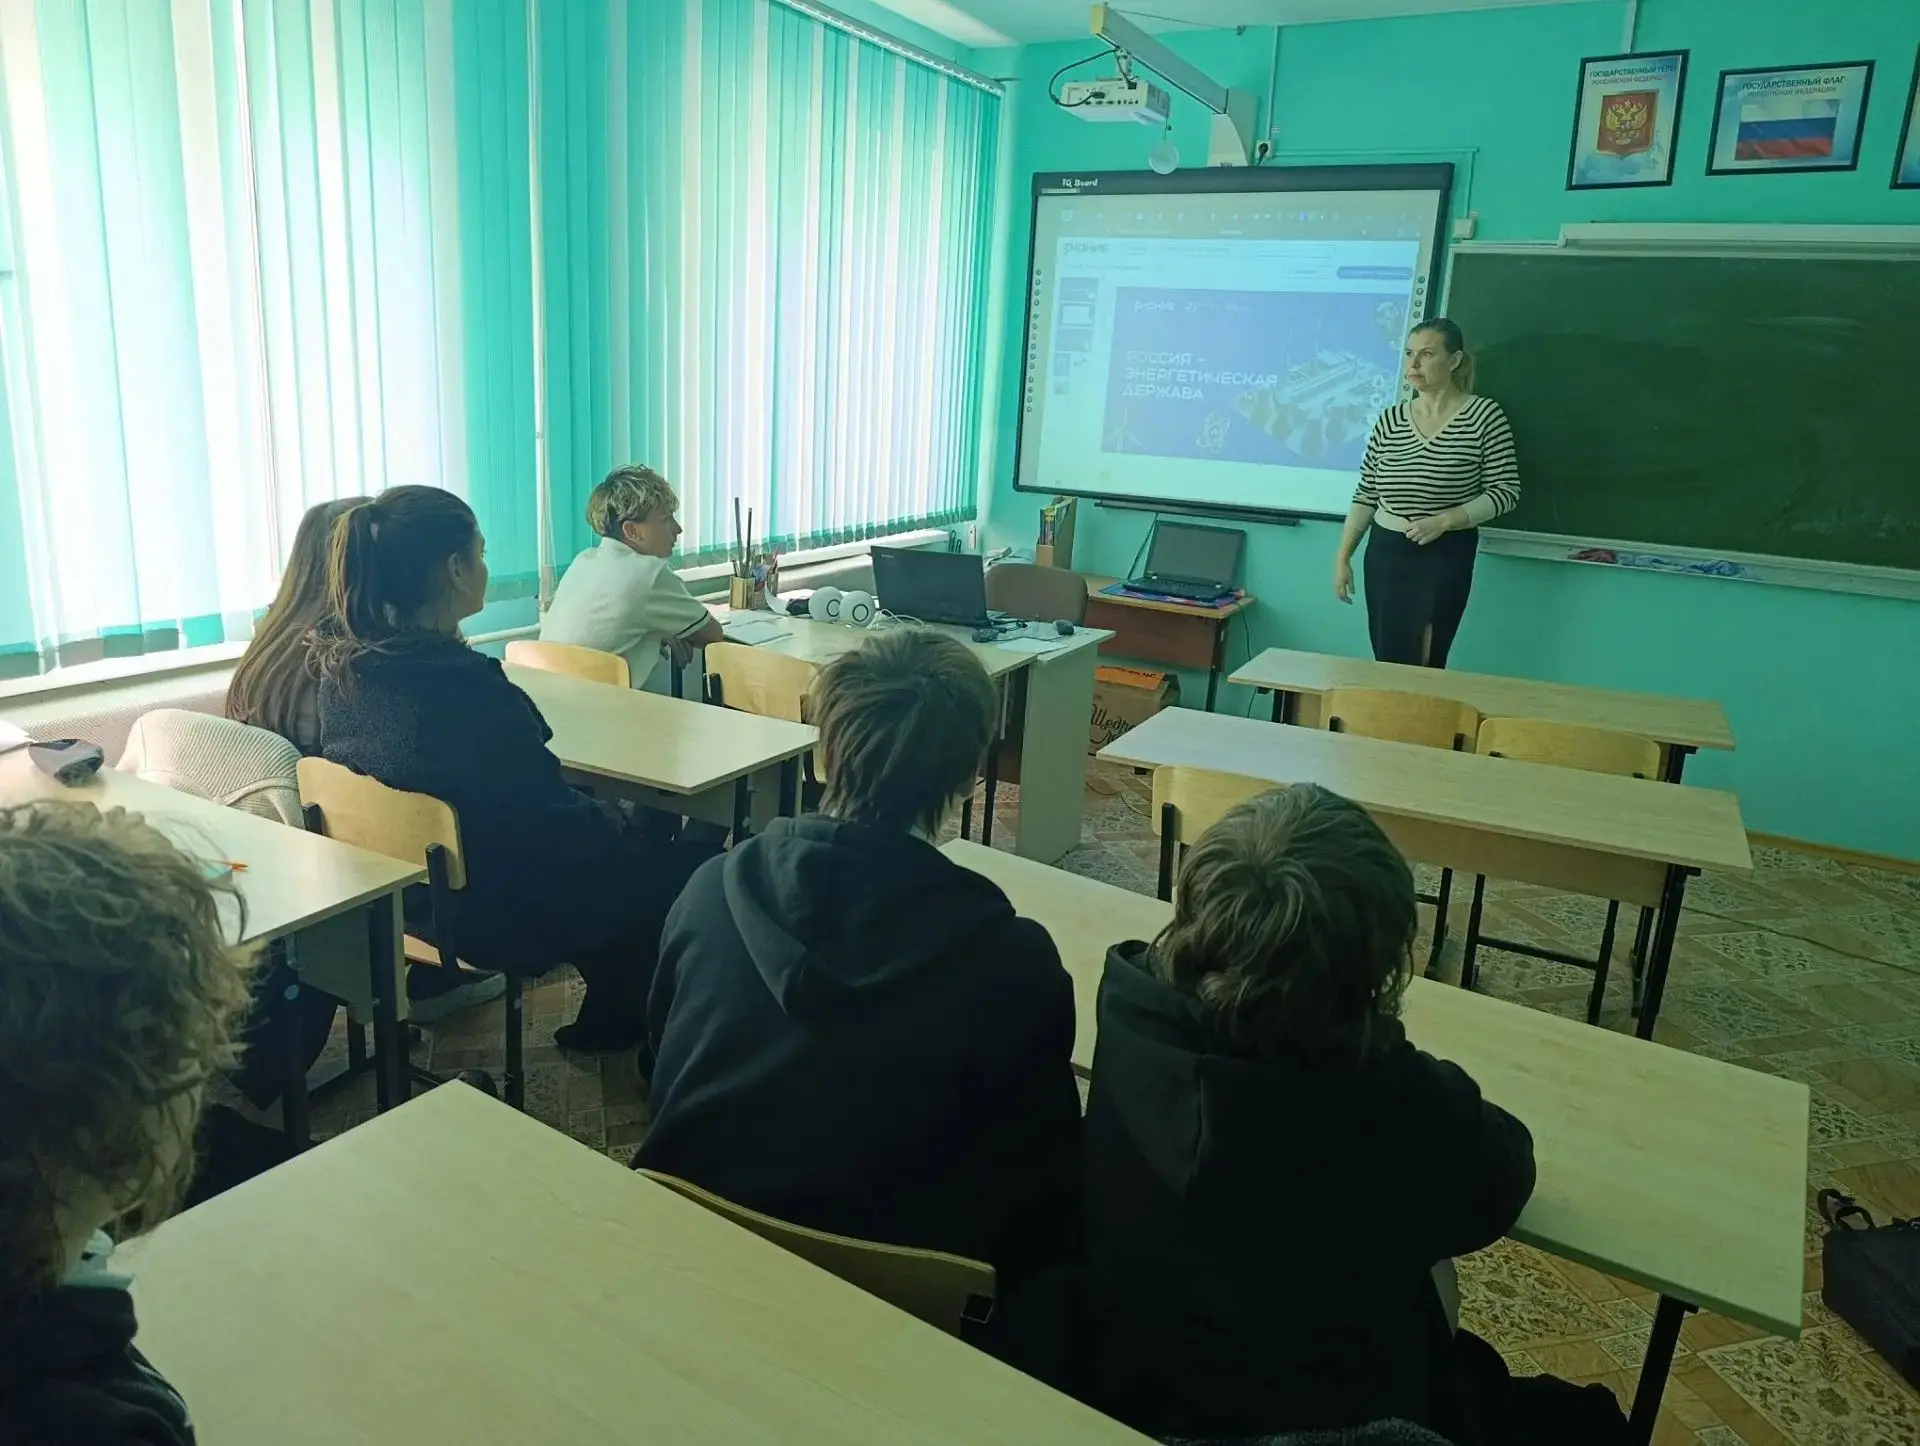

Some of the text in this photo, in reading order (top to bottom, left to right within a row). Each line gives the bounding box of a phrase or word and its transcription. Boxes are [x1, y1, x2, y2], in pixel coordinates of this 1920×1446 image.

[1742, 75, 1846, 90] ГОСУДАРСТВЕННЫЙ ФЛАГ
[1074, 177, 1098, 187] Board
[1125, 350, 1193, 366] РОССИЯ
[1124, 367, 1278, 388] ЭНЕРГЕТИЧЕСКАЯ
[1121, 383, 1204, 400] ДЕРЖАВА
